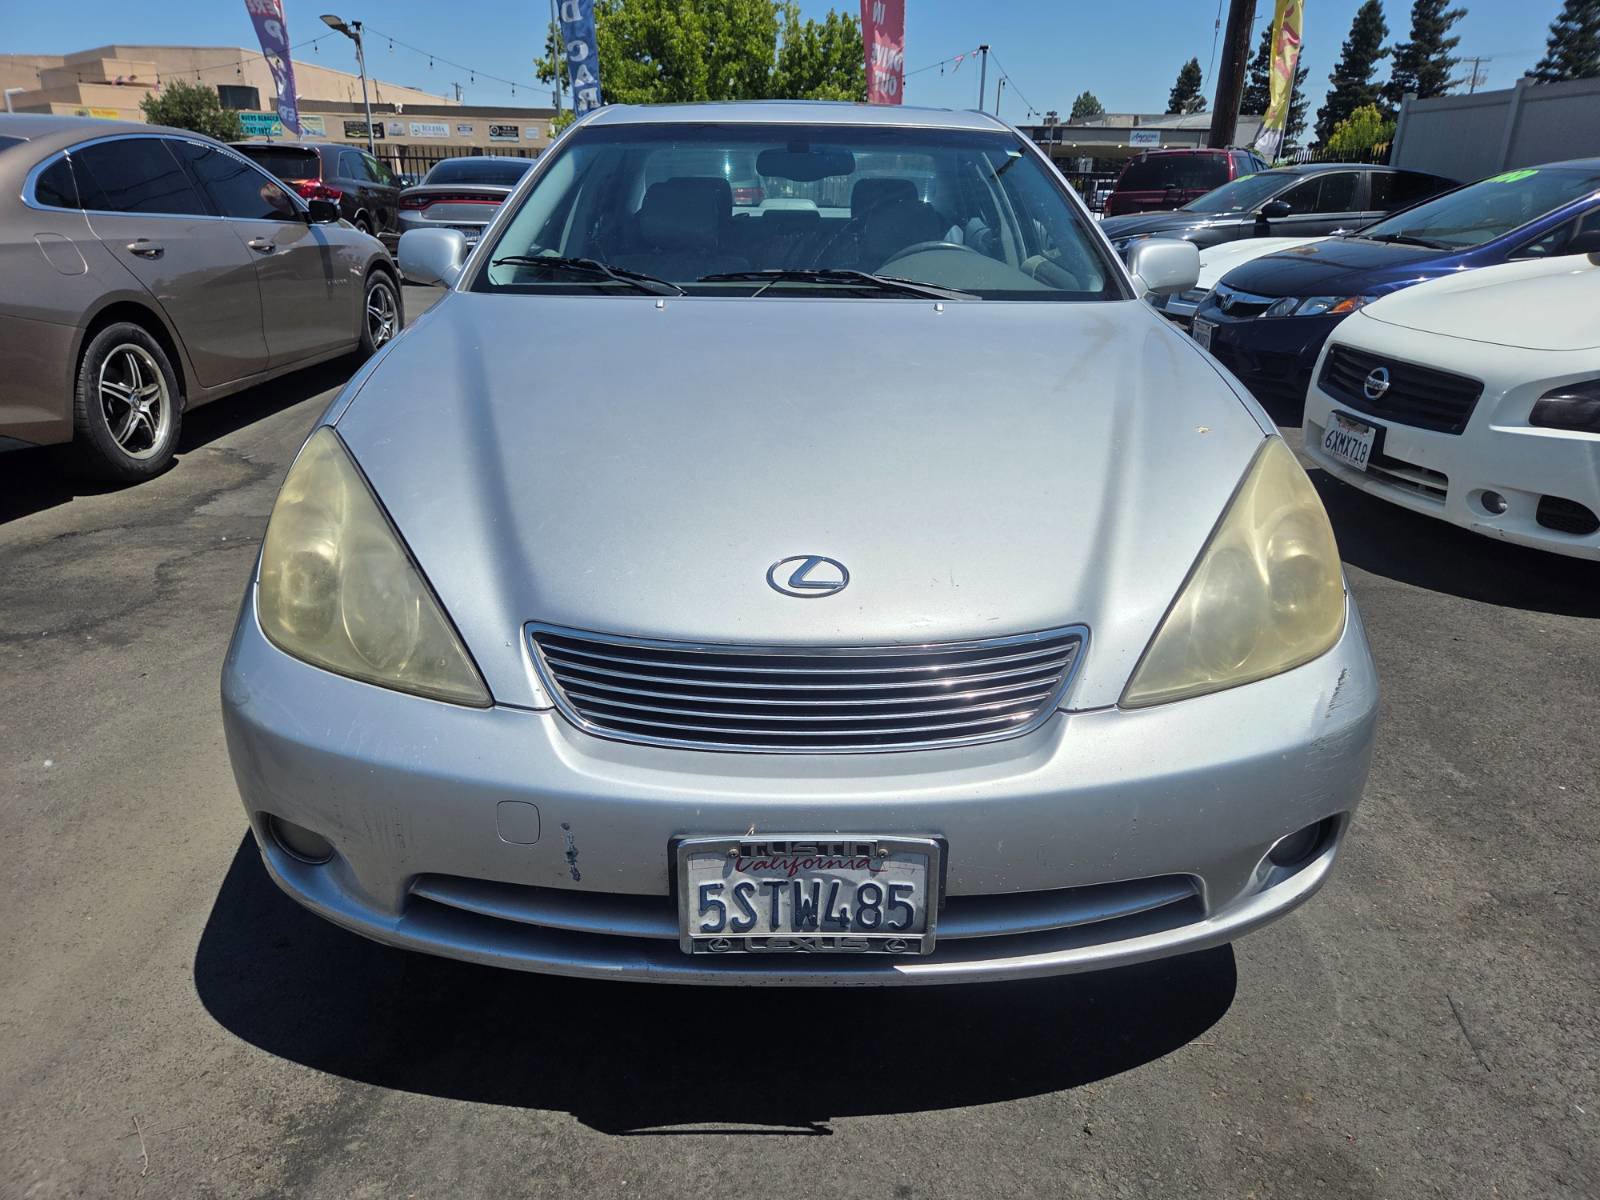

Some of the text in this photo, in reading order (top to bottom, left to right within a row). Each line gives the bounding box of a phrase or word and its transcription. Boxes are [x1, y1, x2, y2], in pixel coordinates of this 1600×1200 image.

[1325, 430, 1368, 464] 6XMX718
[735, 856, 888, 878] California
[698, 880, 916, 935] 5STW485
[744, 935, 871, 953] LEXUS
